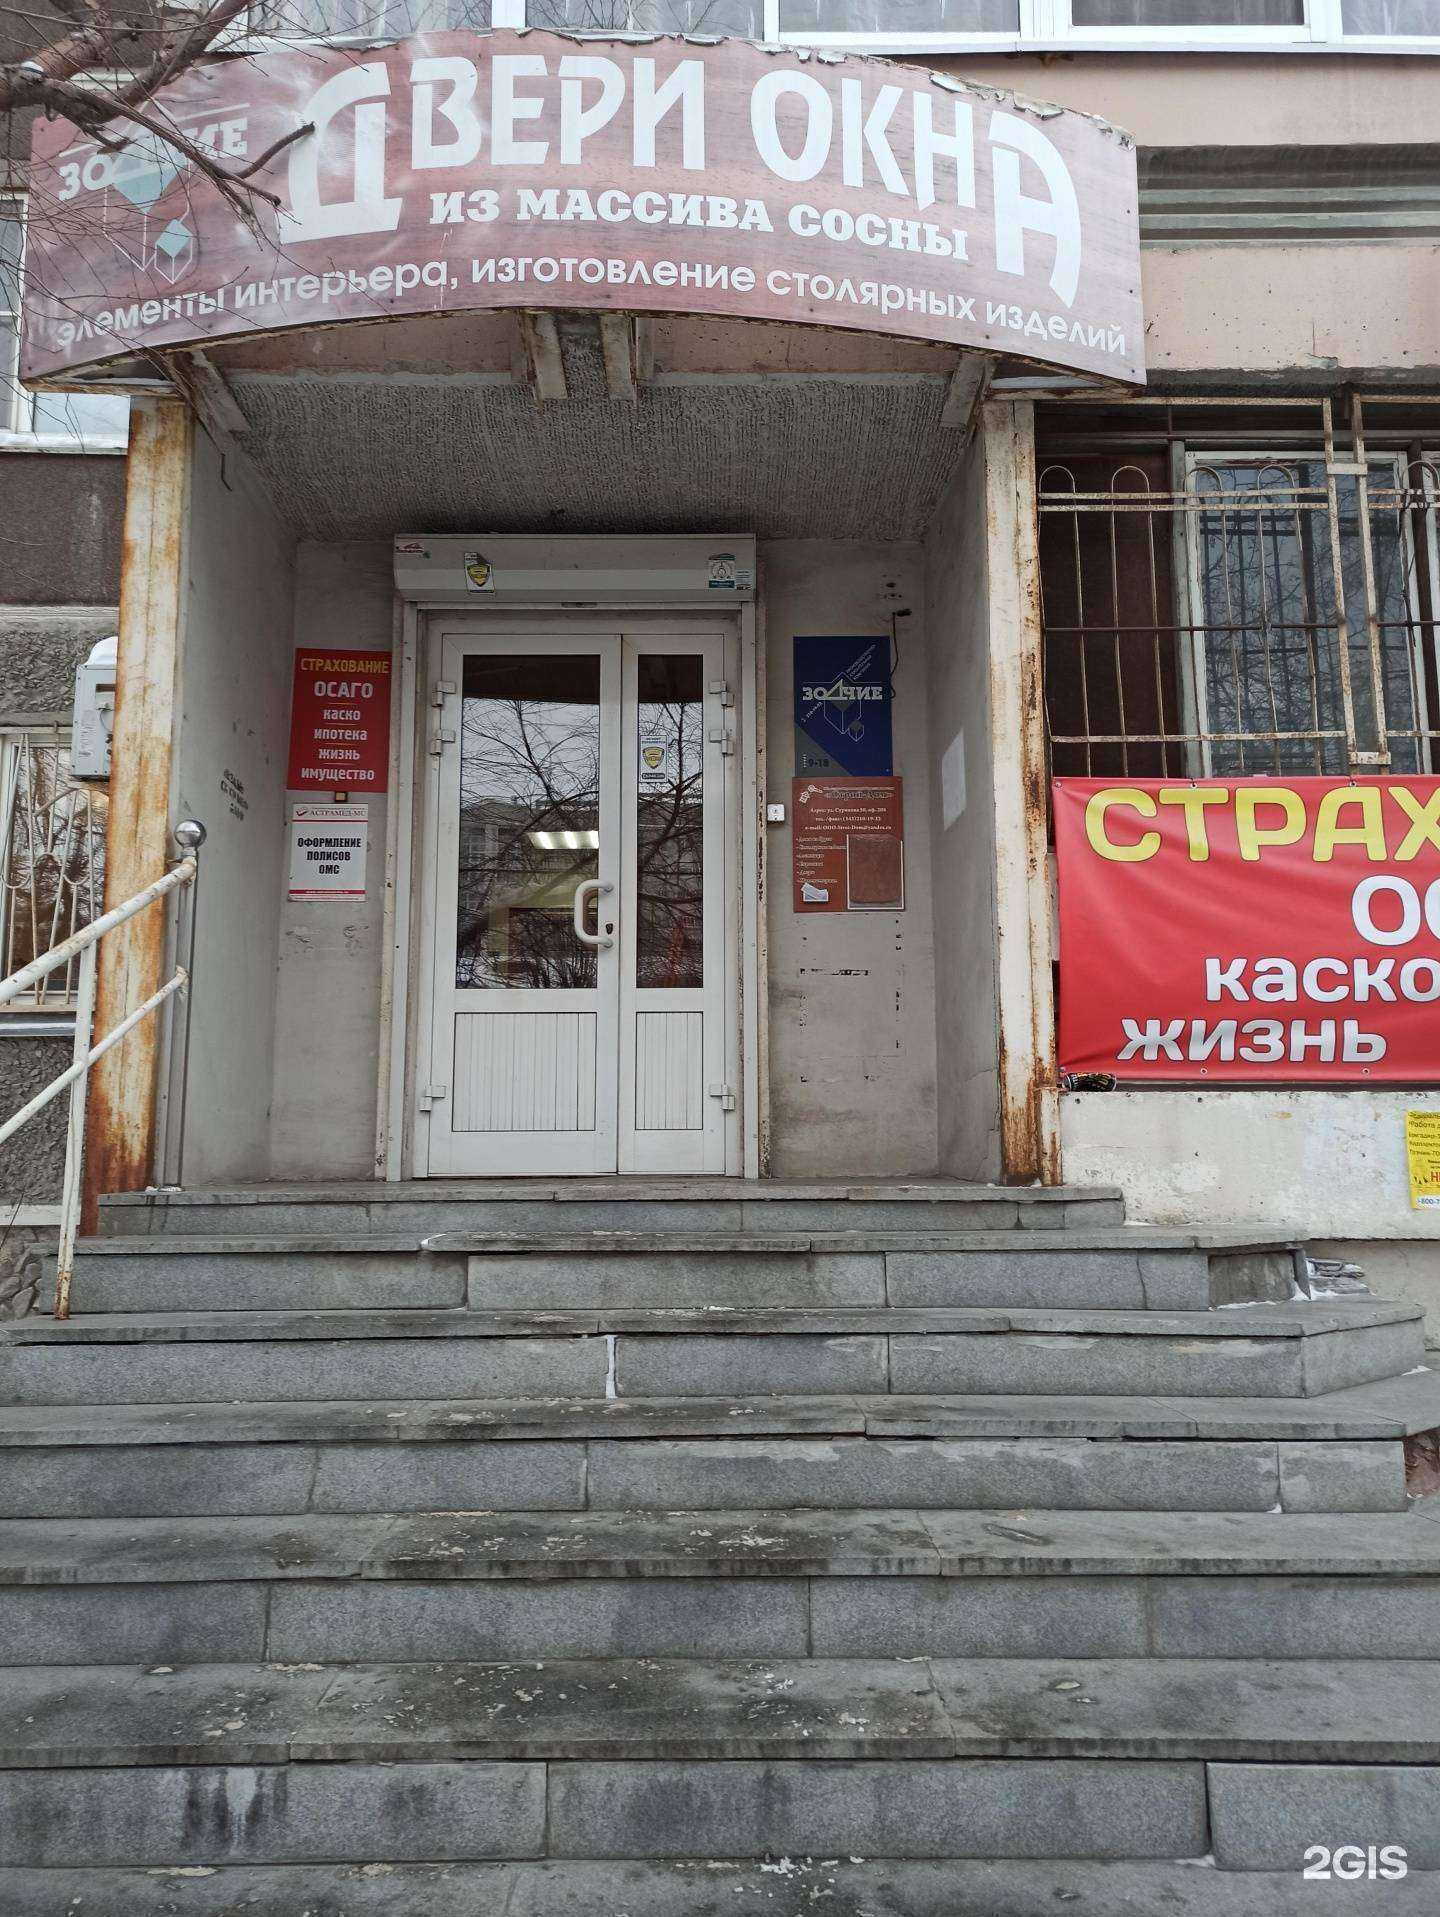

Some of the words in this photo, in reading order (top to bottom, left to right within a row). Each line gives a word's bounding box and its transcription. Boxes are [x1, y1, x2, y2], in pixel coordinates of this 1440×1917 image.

[280, 55, 705, 244] ДВЕРИ
[750, 69, 1082, 309] ОКНА
[430, 189, 499, 224] ИЗ
[516, 188, 774, 233] МАССИВА
[788, 204, 969, 262] СОСНЫ
[55, 286, 224, 347] элементы
[234, 257, 458, 308] интерьера,
[472, 256, 755, 291] изготовление
[766, 270, 975, 321] столярных
[985, 301, 1127, 356] изделий
[300, 658, 390, 674] СТРАХОВАНИЕ
[314, 681, 374, 698] ОСАГО
[801, 679, 883, 701] ЗОДЧИЕ
[323, 708, 361, 721] каско
[313, 728, 369, 741] ипотека
[318, 747, 361, 760] жизнь
[301, 767, 376, 782] имущество
[1085, 786, 1440, 862] СТРАХ
[297, 837, 362, 848] ОФОРМЛЕНИЕ
[307, 851, 351, 861] ПОЛИСОВ
[318, 864, 340, 875] ОМС
[1351, 874, 1440, 946] О
[1205, 956, 1440, 1003] каско
[1116, 1018, 1388, 1064] жизнь
